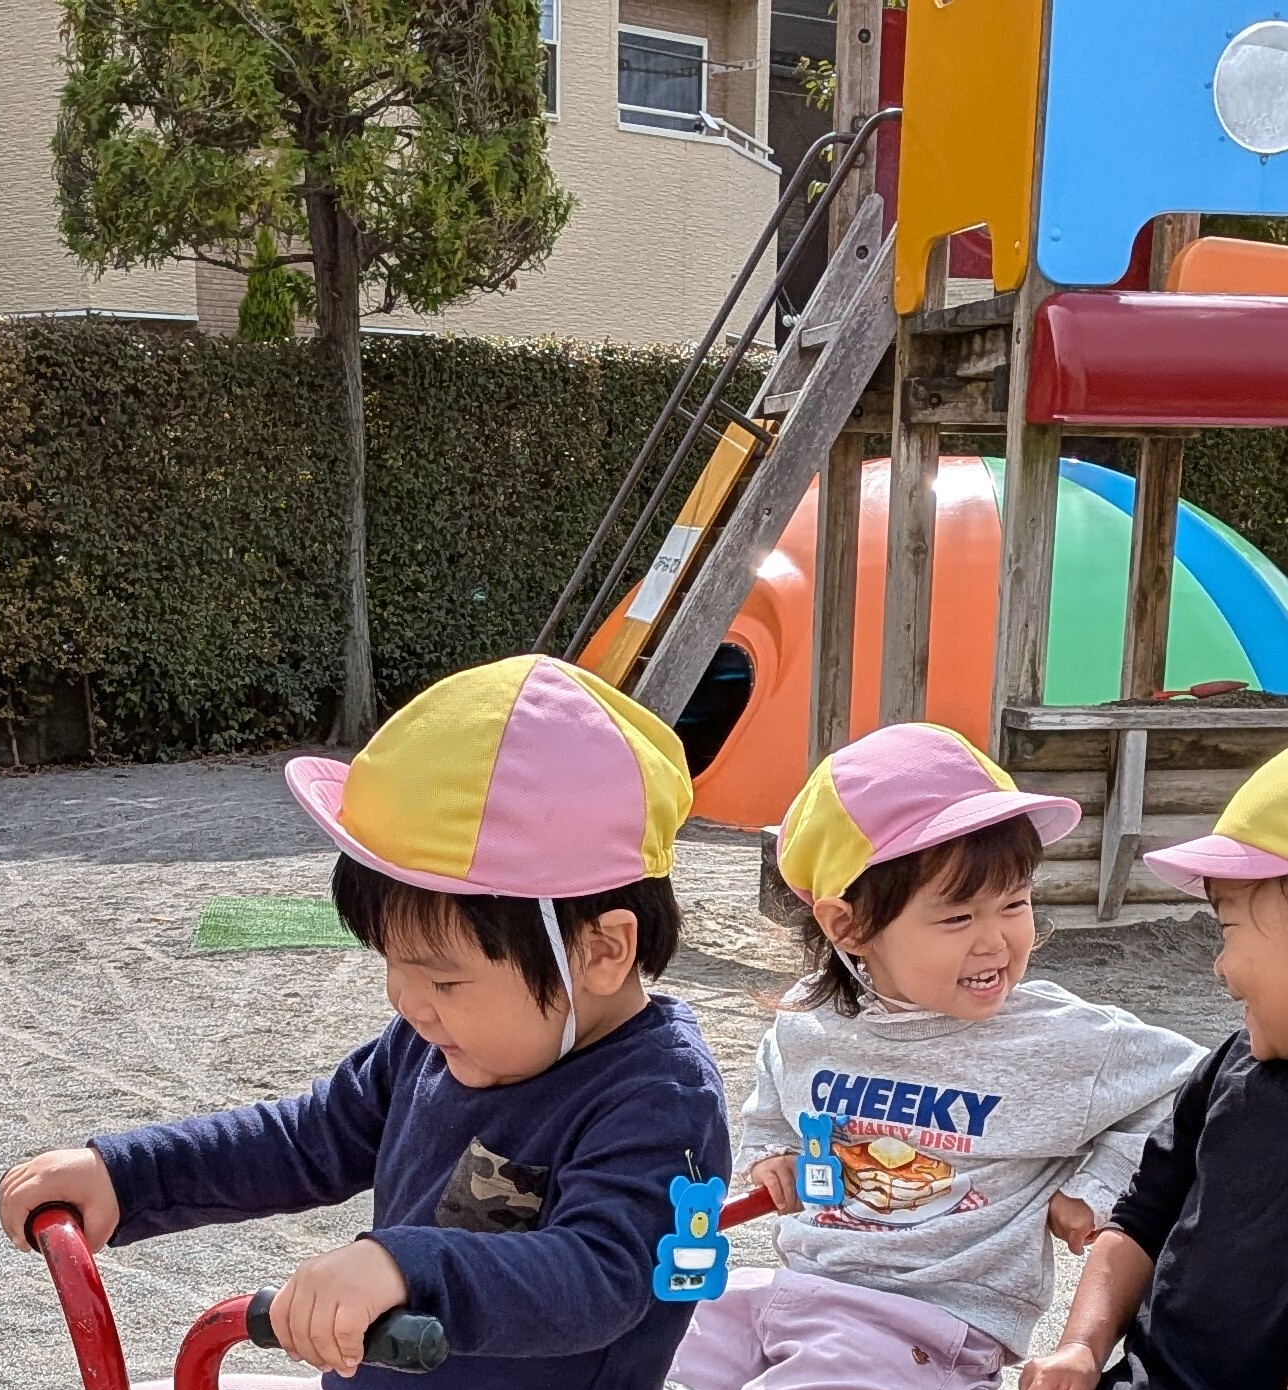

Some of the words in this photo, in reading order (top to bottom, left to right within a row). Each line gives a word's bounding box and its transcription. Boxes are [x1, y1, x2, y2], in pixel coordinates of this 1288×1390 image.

[811, 1069, 1003, 1138] CHEEKY
[840, 1118, 912, 1142] CIALTY
[919, 1129, 972, 1154] DISH
